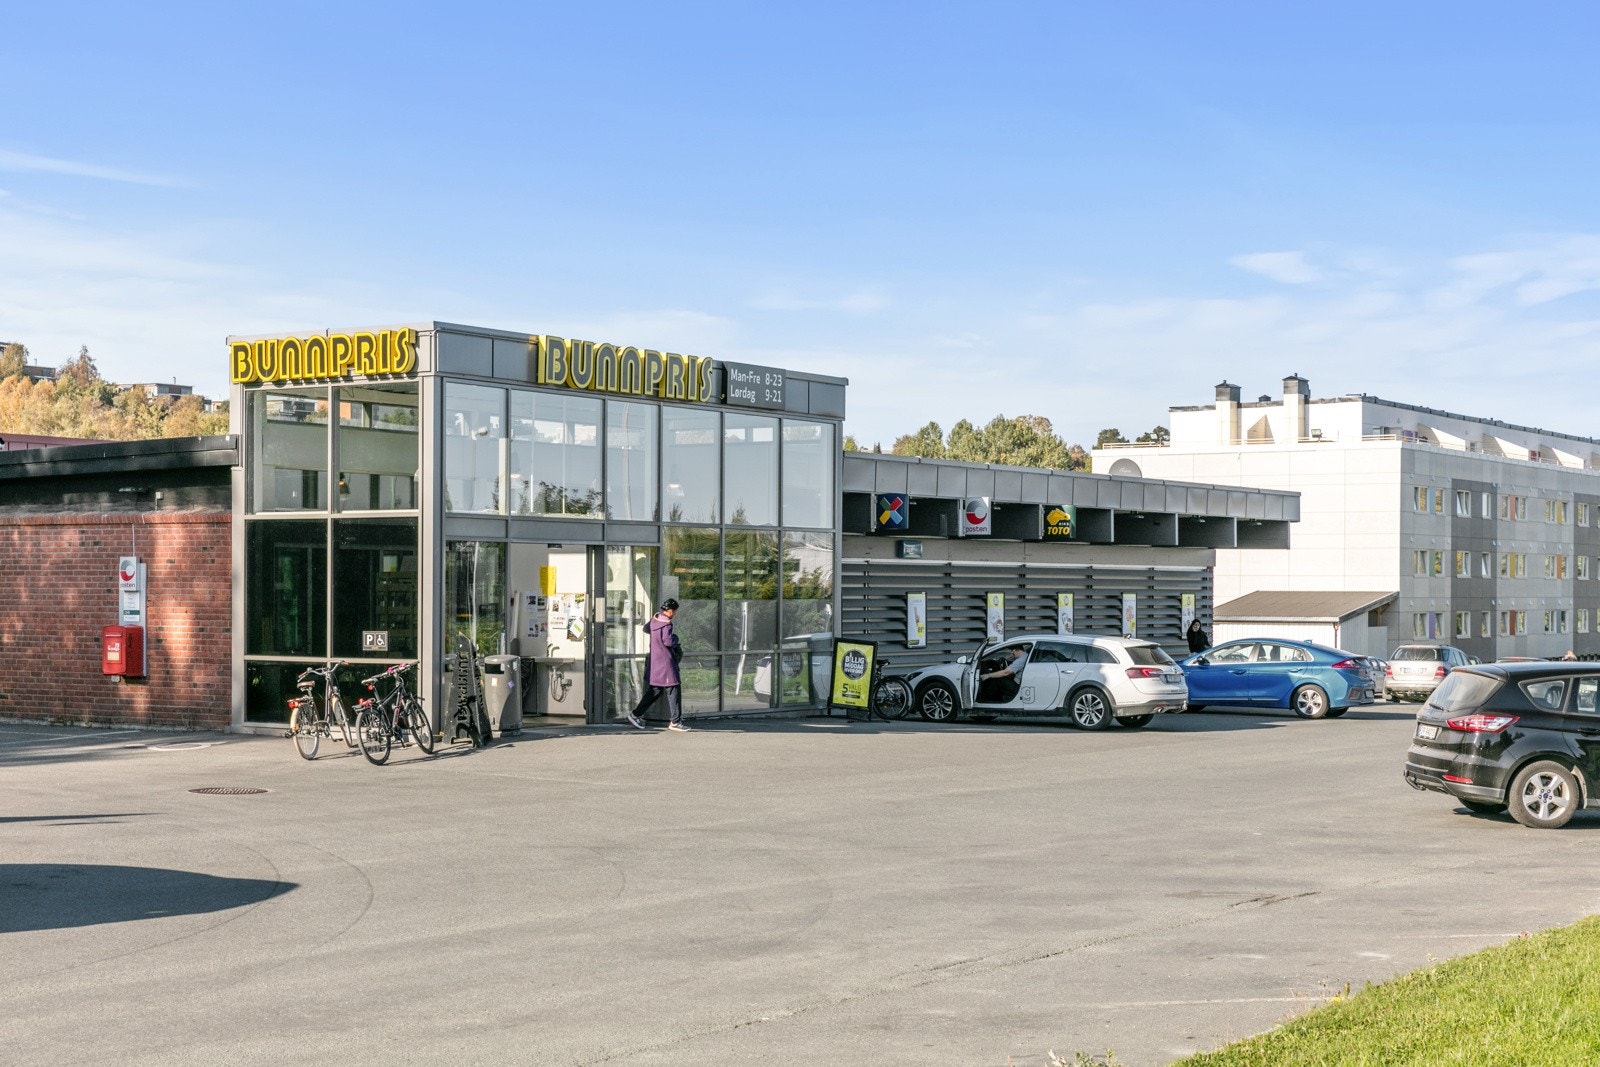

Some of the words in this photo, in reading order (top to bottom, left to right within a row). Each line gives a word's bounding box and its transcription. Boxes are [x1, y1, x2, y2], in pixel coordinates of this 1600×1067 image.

[231, 327, 417, 383] BUNNPRIS
[539, 334, 713, 403] BUNNPRIS
[730, 368, 761, 384] Man-Fre
[765, 373, 783, 387] 8-23
[730, 384, 756, 403] Lørdag
[765, 389, 782, 403] 9-21
[965, 525, 988, 533] posten
[1047, 526, 1070, 535] TOTO
[366, 634, 374, 646] P
[841, 683, 849, 694] 5
